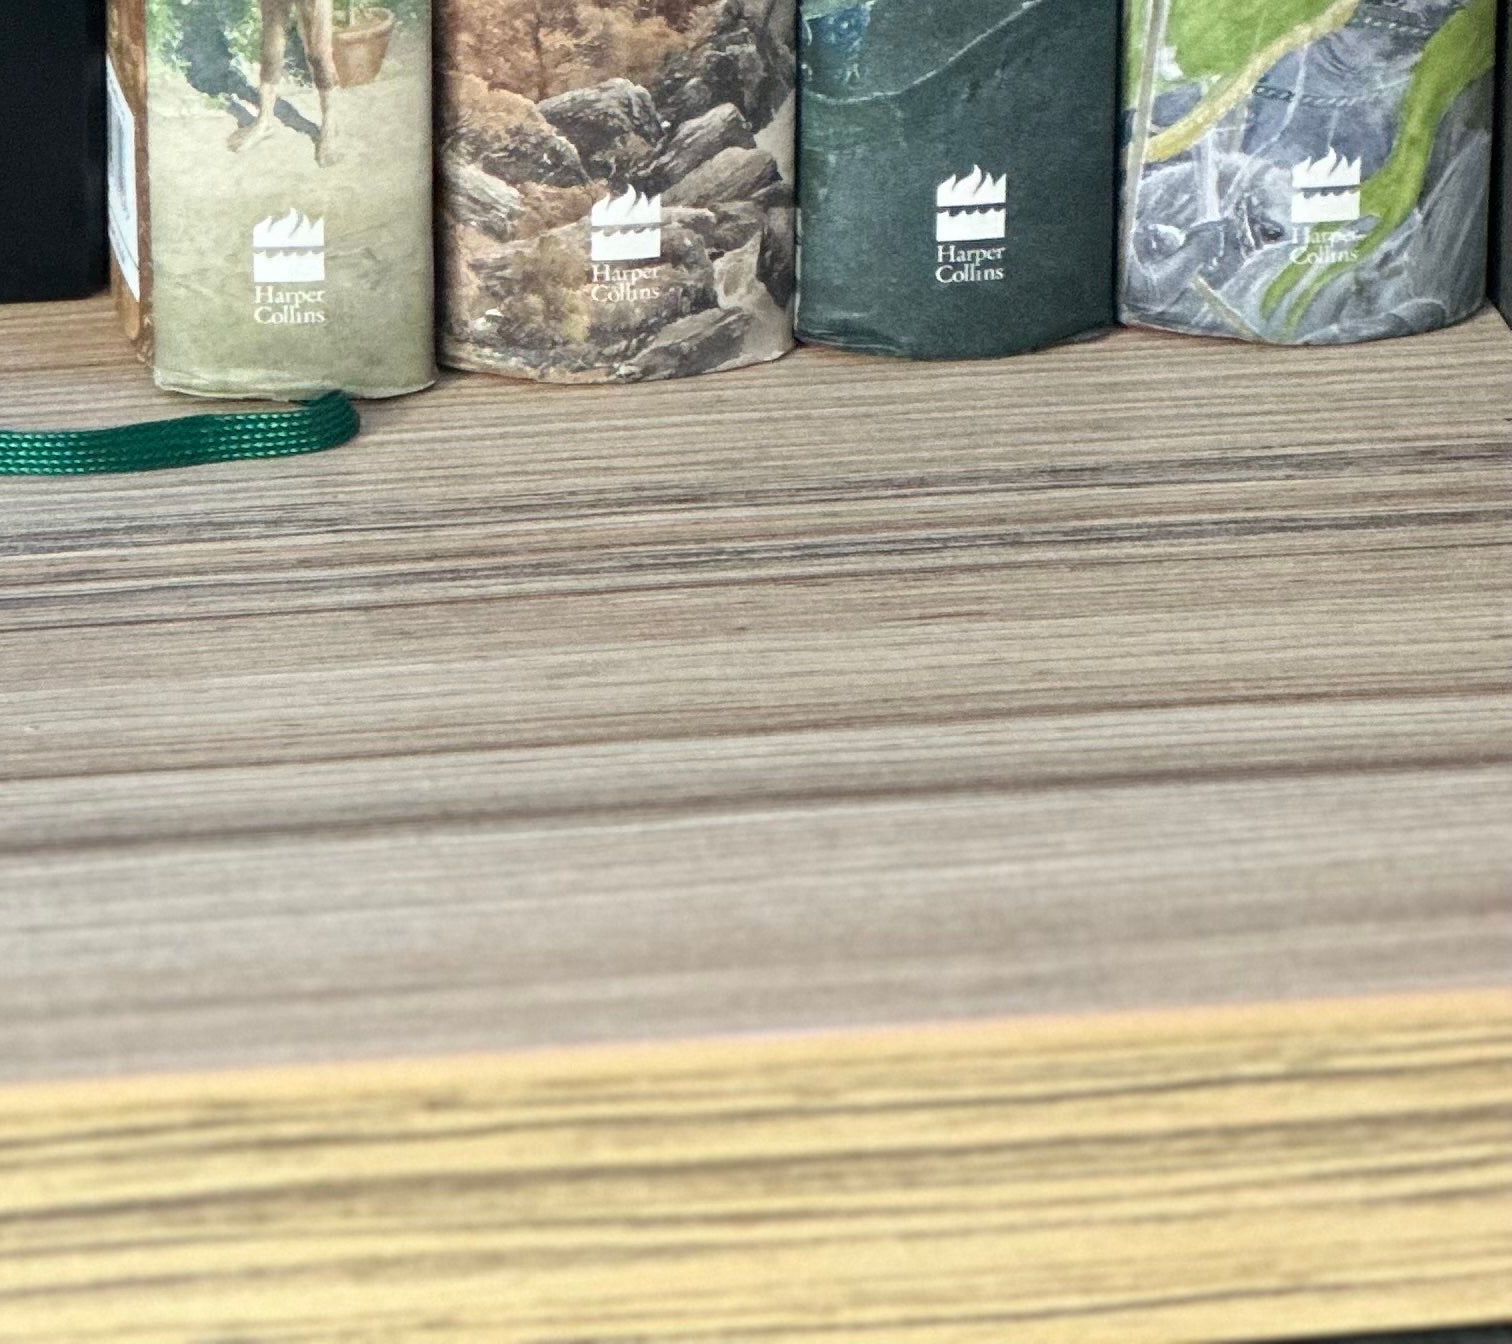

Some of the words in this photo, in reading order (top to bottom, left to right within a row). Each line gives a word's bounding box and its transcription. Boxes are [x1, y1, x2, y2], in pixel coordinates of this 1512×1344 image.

[936, 244, 1006, 268] Harper
[1288, 244, 1359, 265] Collins
[591, 263, 660, 286] Harper
[935, 262, 1005, 284] Collins
[254, 285, 325, 308] Harper
[590, 281, 660, 303] Collins
[253, 302, 326, 324] Collins
